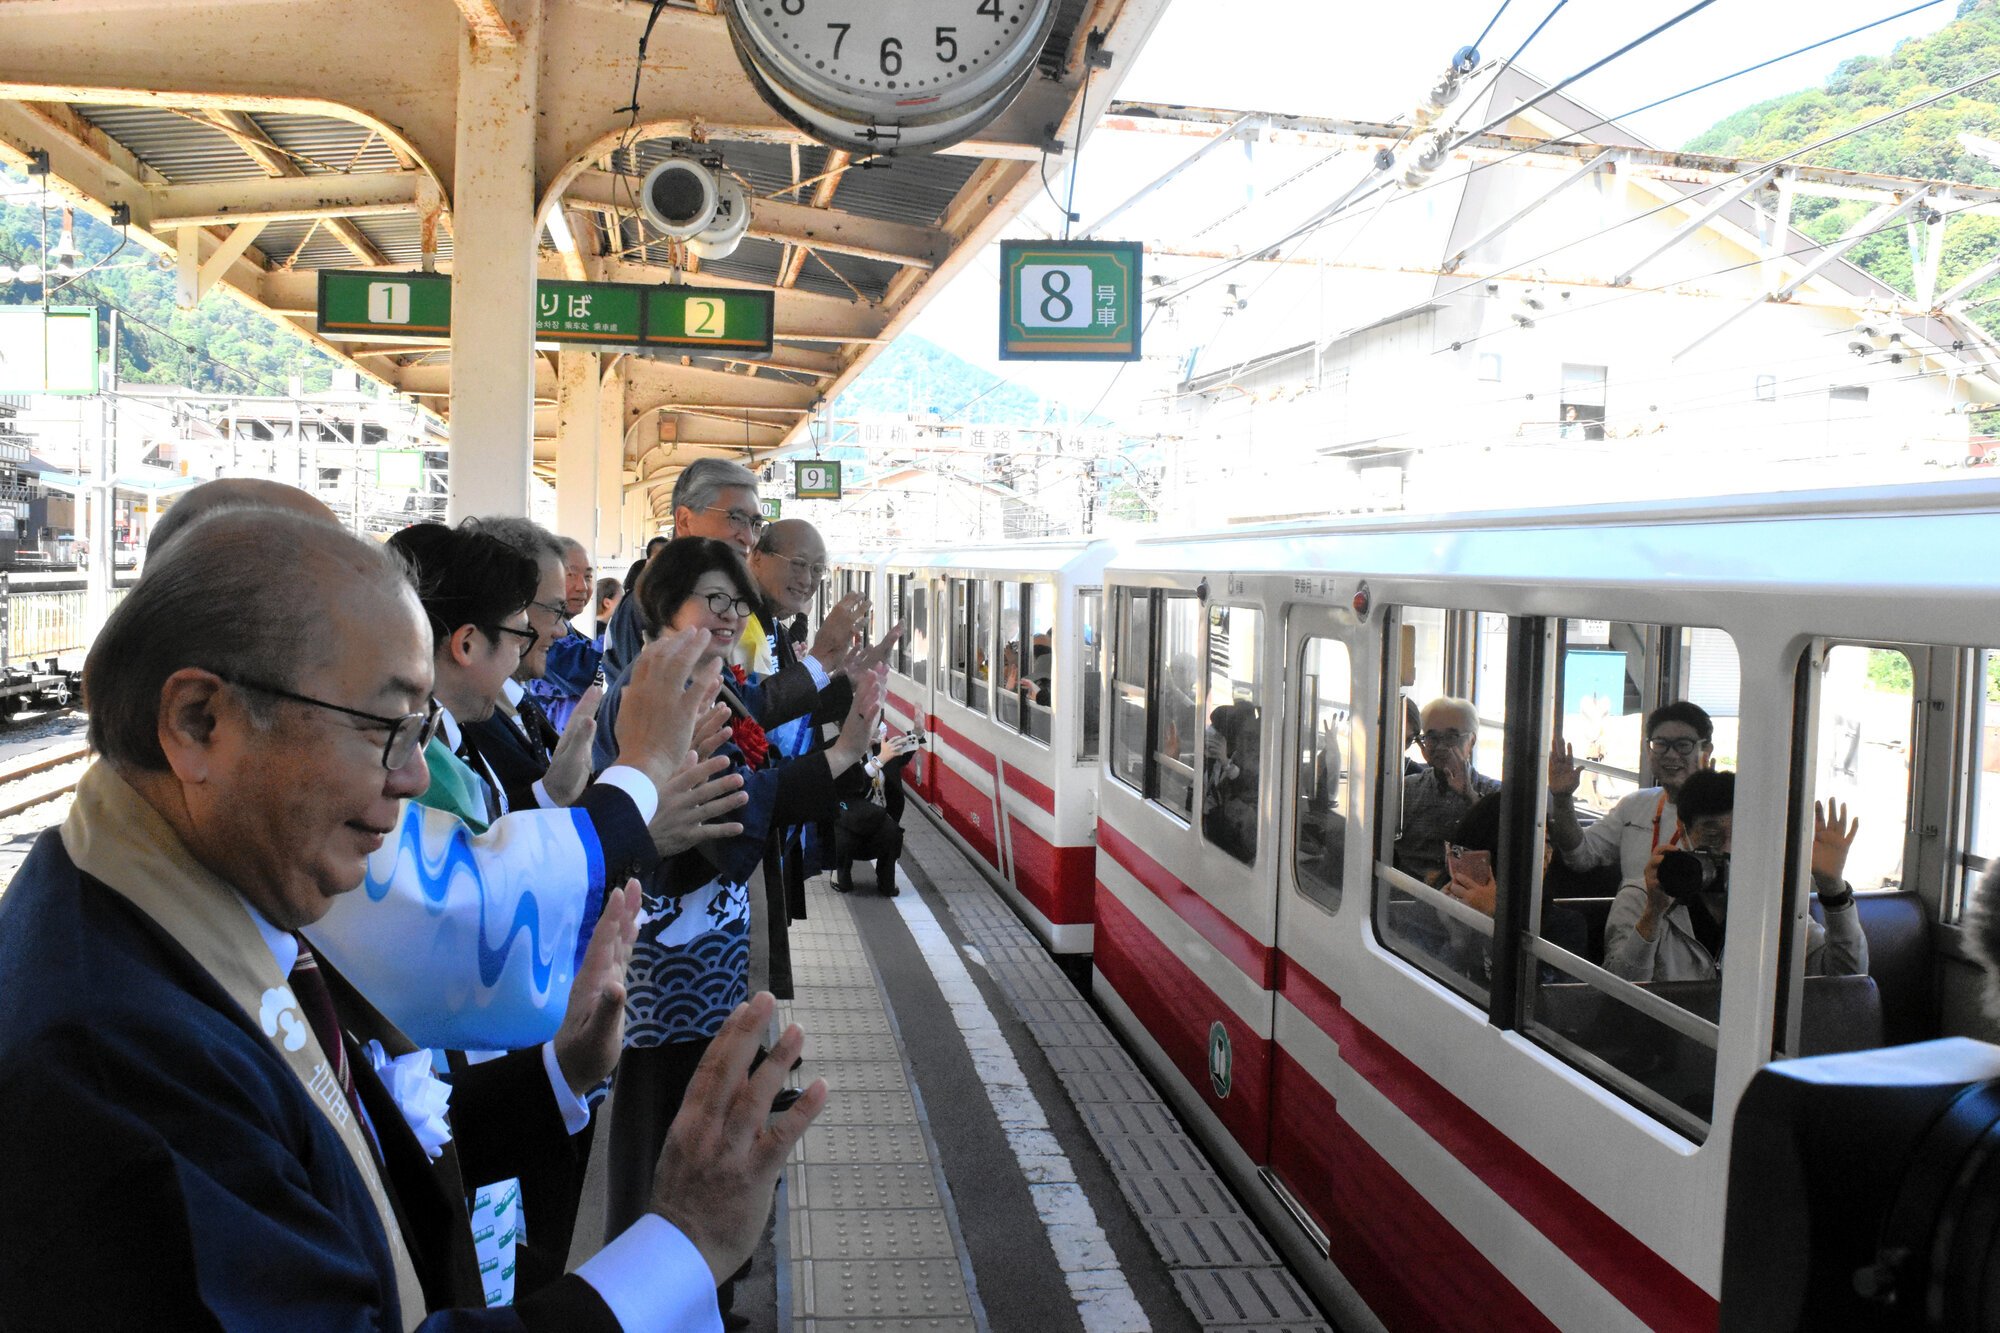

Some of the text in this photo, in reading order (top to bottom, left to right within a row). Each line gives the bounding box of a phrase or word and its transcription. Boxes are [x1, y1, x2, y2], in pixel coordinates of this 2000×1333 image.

[827, 23, 851, 60] 7
[879, 37, 903, 76] 6
[935, 27, 957, 62] 5
[381, 286, 395, 320] 1
[1040, 270, 1073, 322] 8
[1096, 285, 1117, 327] 号車
[694, 301, 716, 334] 2
[807, 469, 819, 488] 9
